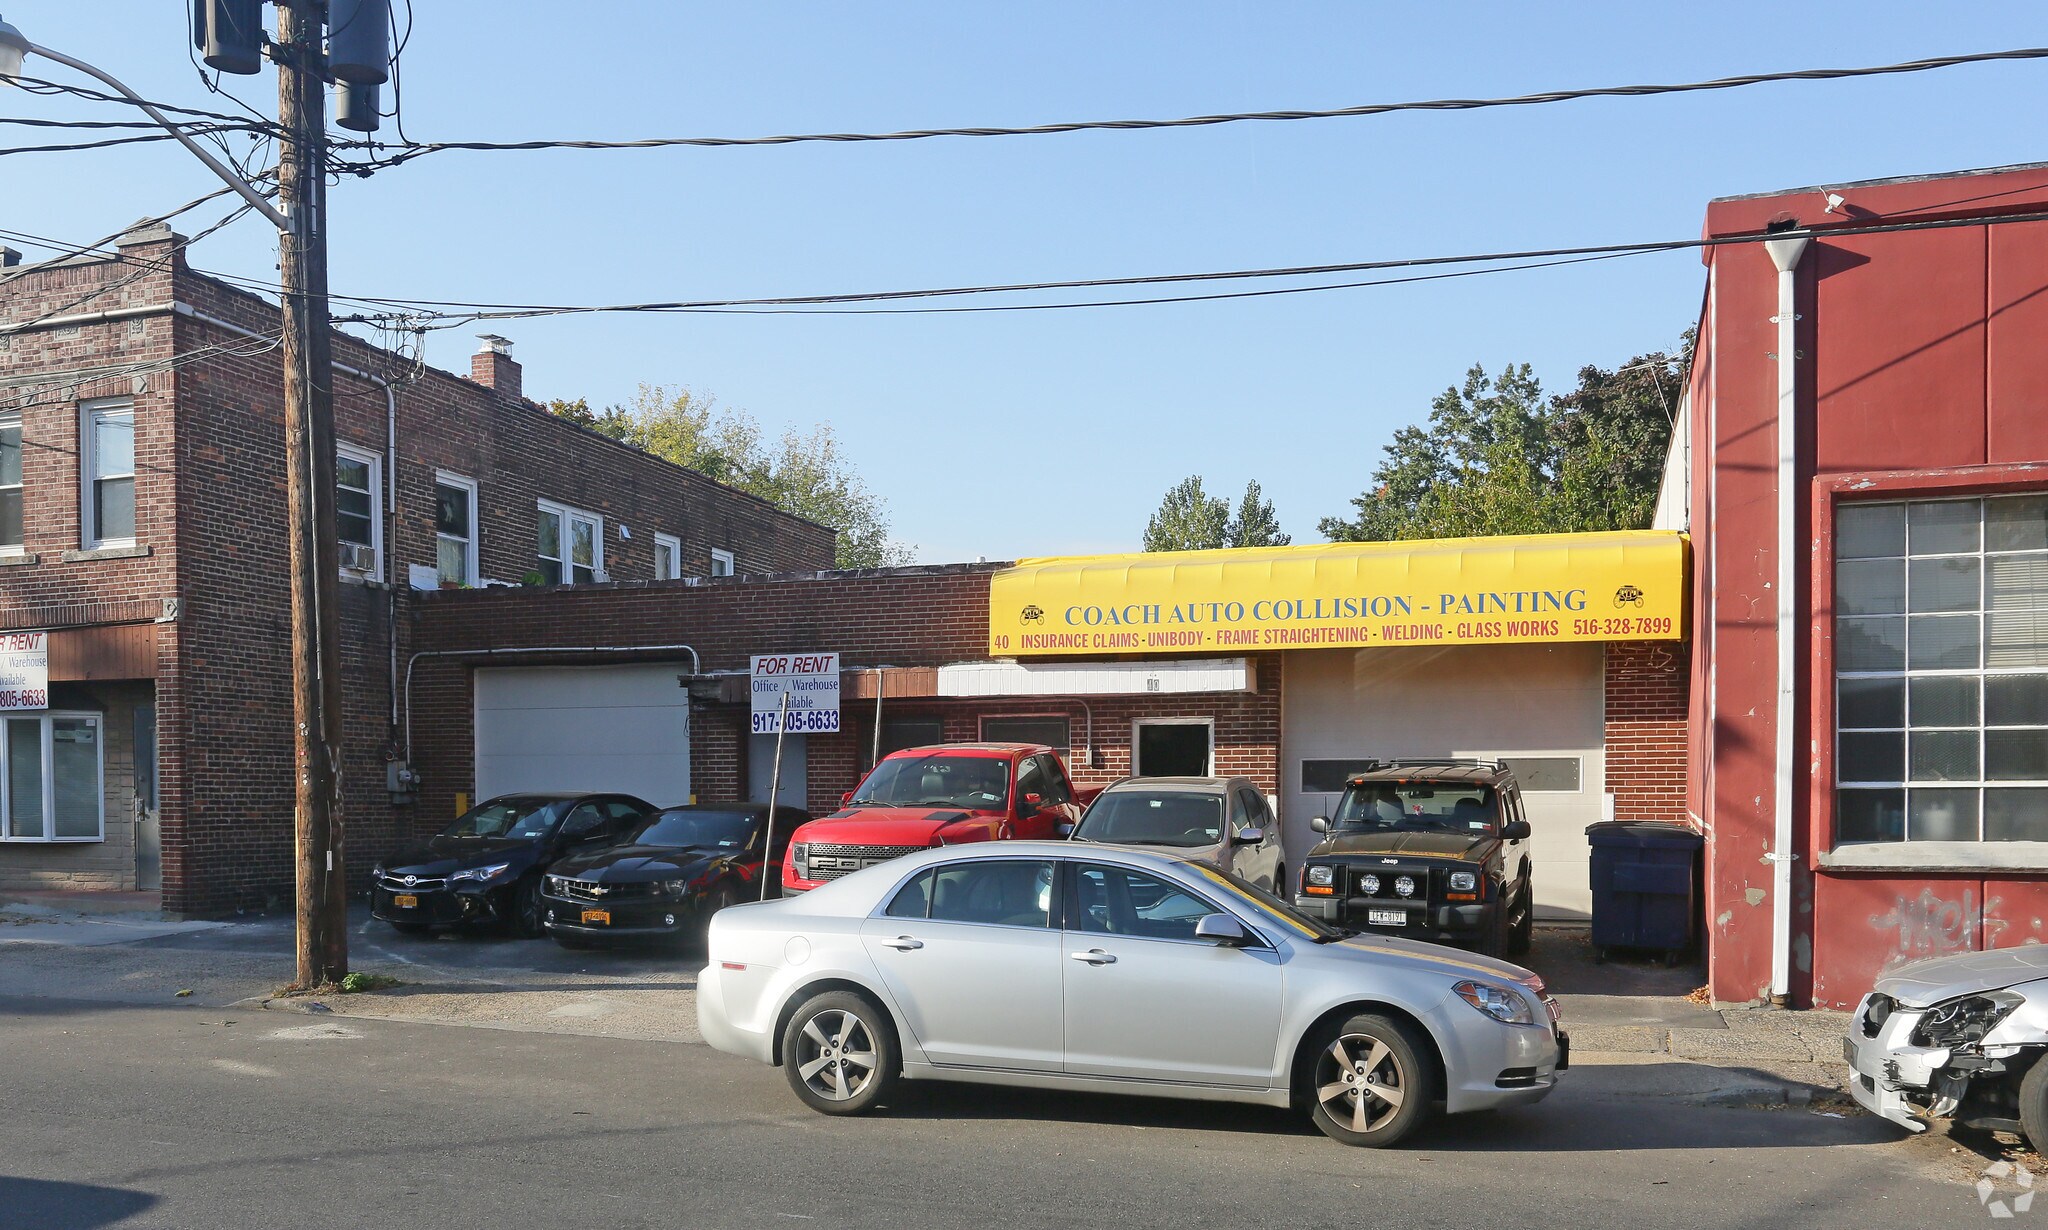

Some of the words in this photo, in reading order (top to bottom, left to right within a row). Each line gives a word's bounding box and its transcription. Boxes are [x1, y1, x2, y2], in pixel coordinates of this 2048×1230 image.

[1065, 604, 1160, 626] COACH
[1168, 601, 1245, 624] AUTO
[1253, 595, 1412, 621] COLLISION
[1440, 589, 1587, 615] PAINTING
[994, 635, 1010, 649] 40
[1021, 633, 1089, 648] INSURANCE
[1093, 632, 1139, 647] CLAIMS
[1148, 631, 1203, 646] UNIBODY
[1216, 629, 1259, 645] FRAME
[1264, 626, 1368, 644] STRAIGHTENING
[1382, 623, 1443, 640] WELDING
[1457, 621, 1502, 638] GLASS
[1507, 620, 1559, 637] WORKS
[1573, 617, 1672, 635] 516-328-7899
[9, 633, 42, 650] RENT
[9, 655, 47, 668] Warehouse
[756, 657, 788, 675] FOR
[792, 656, 834, 673] RENT
[0, 672, 26, 686] vailable
[753, 680, 779, 692] Office
[792, 678, 838, 691] Warehouse
[777, 696, 814, 708] Aailable
[1381, 857, 1399, 865] Jeep
